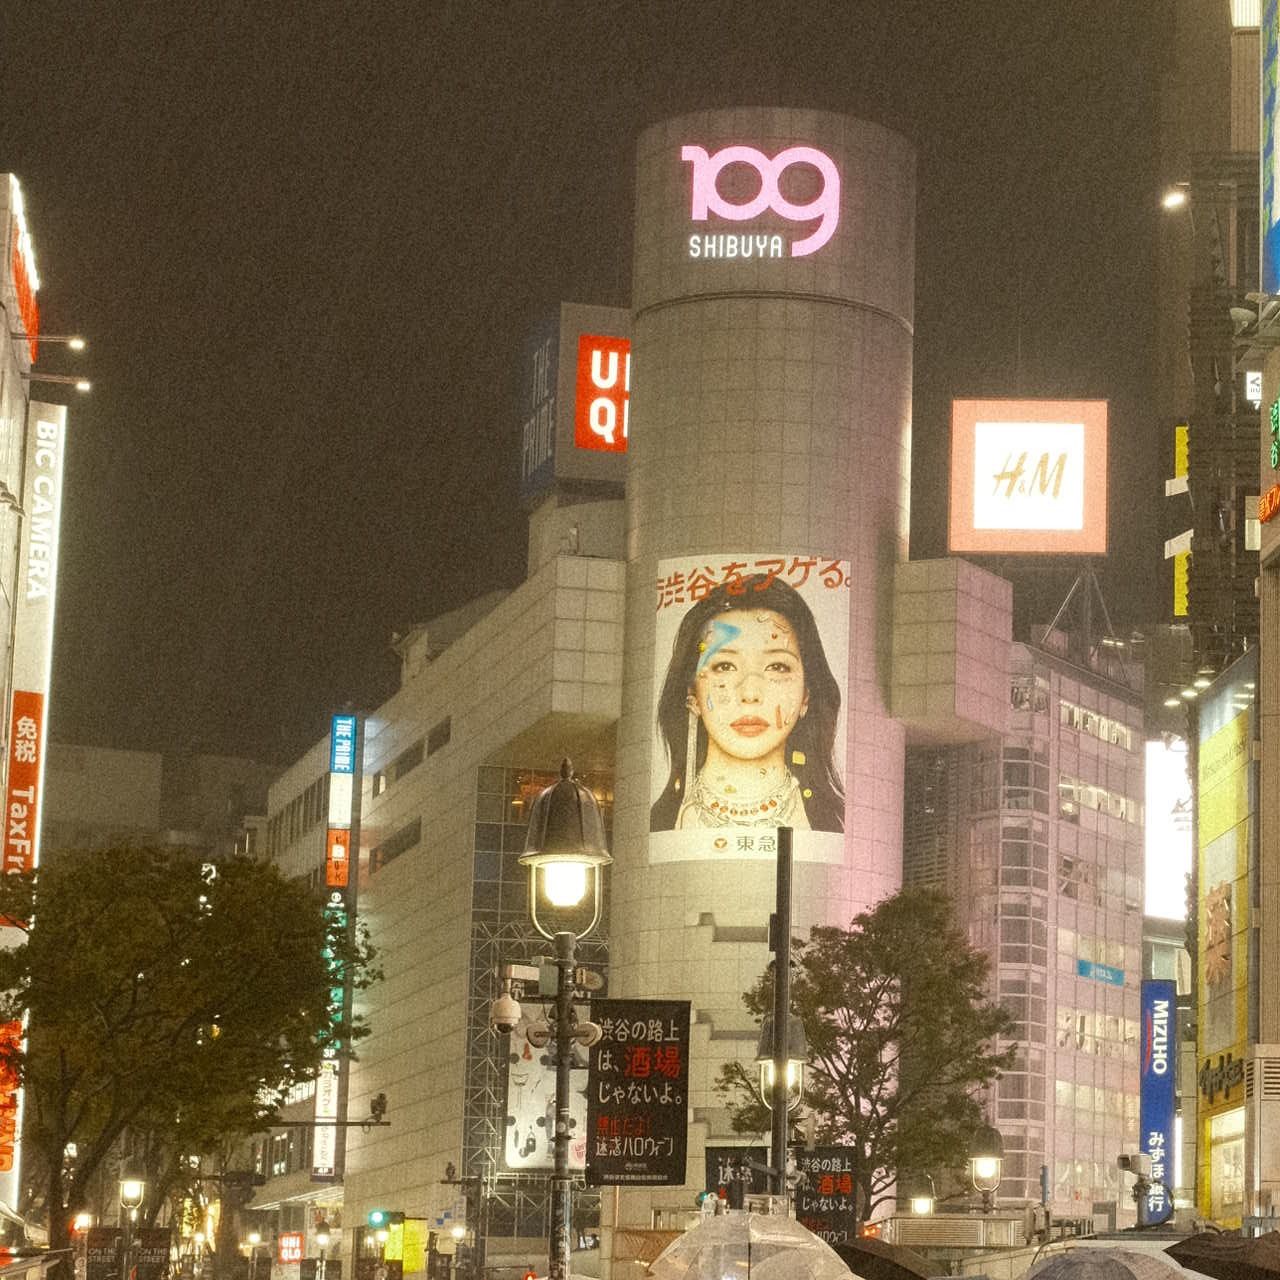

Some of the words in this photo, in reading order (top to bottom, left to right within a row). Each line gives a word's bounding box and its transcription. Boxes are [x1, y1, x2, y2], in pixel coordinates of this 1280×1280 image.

[681, 145, 840, 257] 109
[689, 234, 782, 258] SHIBUYA
[34, 419, 58, 468] BIC
[992, 450, 1068, 497] H&M
[26, 474, 55, 601] CAMERA
[15, 716, 38, 764] 免税
[600, 1018, 680, 1042] 渋谷の路上
[1151, 999, 1169, 1075] MIZUHO
